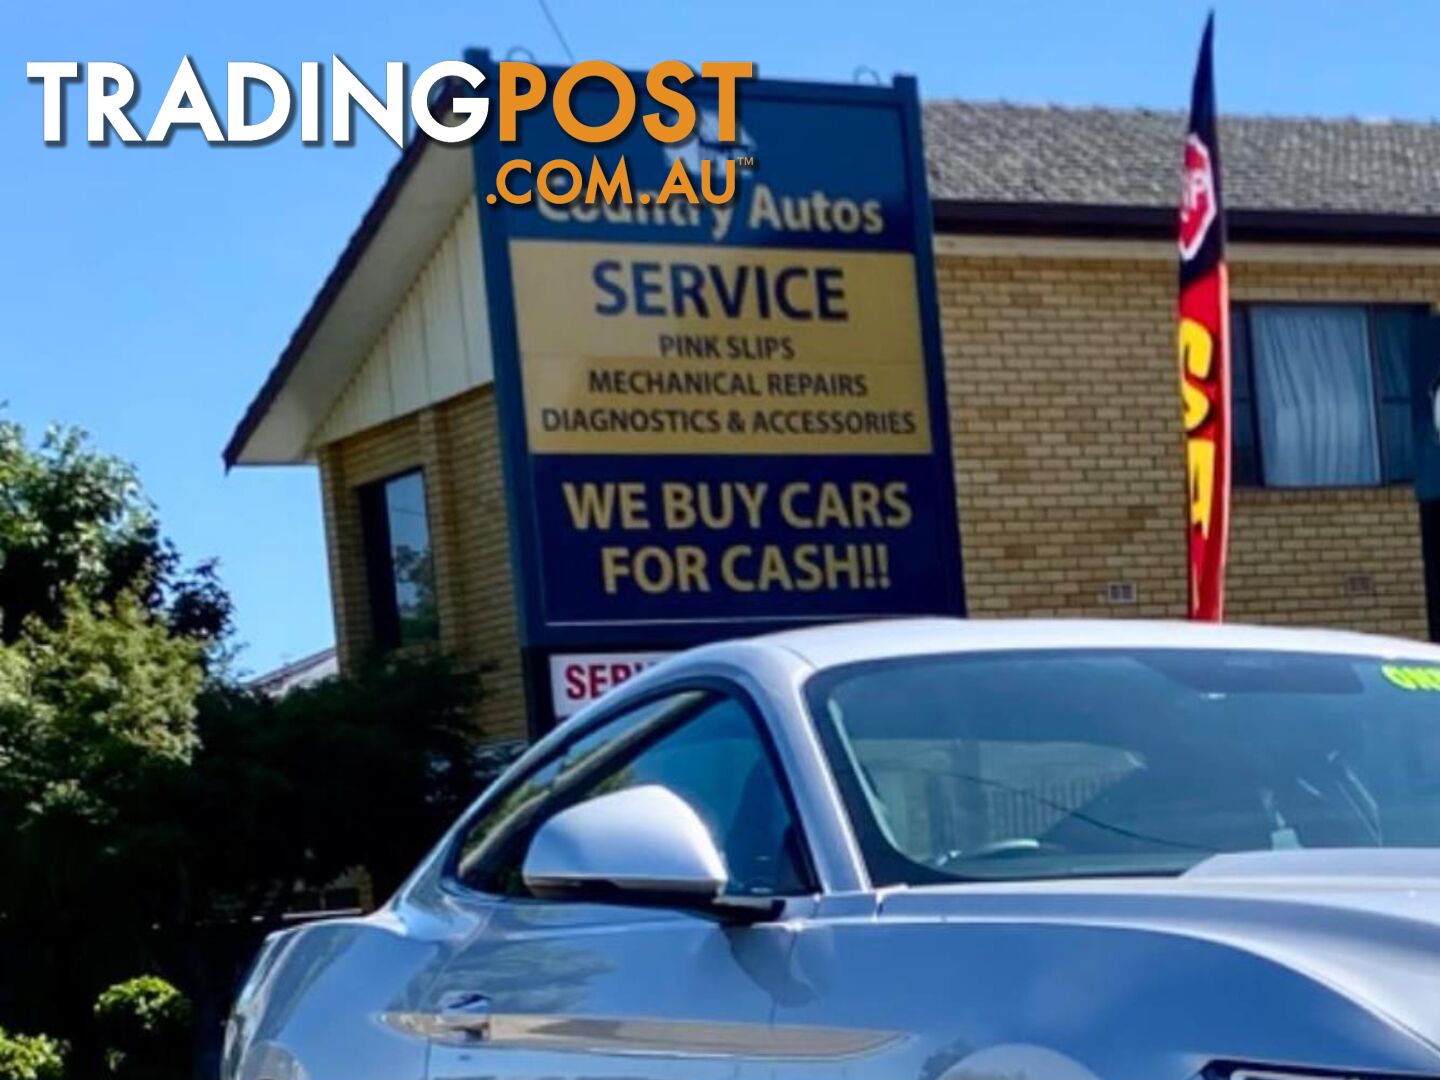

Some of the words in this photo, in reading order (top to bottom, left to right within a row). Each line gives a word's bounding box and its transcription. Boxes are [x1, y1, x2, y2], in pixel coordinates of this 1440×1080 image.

[749, 185, 883, 233] Autos
[592, 260, 850, 322] SERVICE
[658, 334, 719, 359] PINK
[727, 336, 796, 361] SLIPS
[587, 369, 761, 396] MECHANICAL
[767, 373, 868, 398] REPAIRS
[542, 408, 725, 434] DIAGNOSTICS
[728, 411, 746, 434] &
[754, 411, 916, 436] ACCESSORIES
[562, 482, 651, 530] WE
[661, 482, 768, 530] BUY
[779, 482, 913, 529] CARS
[602, 545, 711, 594] FOR
[720, 543, 891, 592] CASH!!
